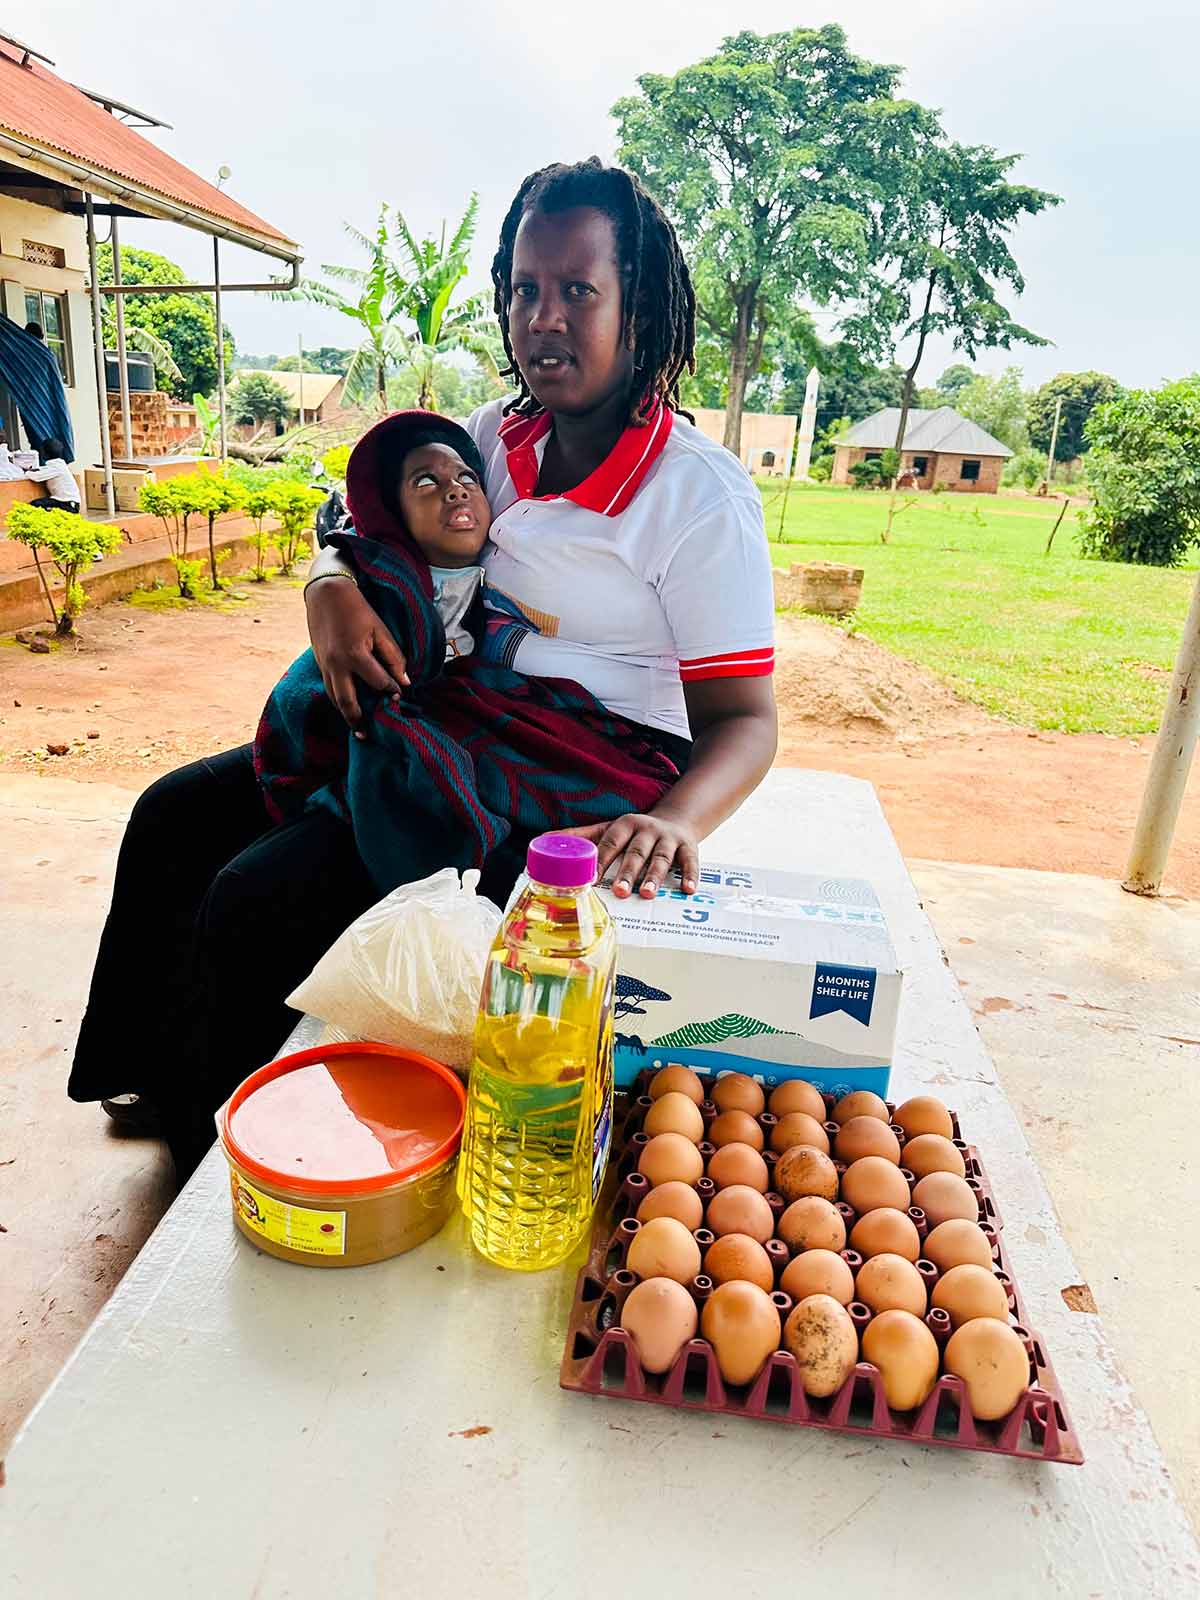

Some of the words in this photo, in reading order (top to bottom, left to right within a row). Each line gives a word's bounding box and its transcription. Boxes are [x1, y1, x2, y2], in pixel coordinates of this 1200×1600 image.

[642, 919, 666, 927] STACK
[692, 924, 714, 932] THAN
[721, 927, 758, 937] CARTONS
[700, 933, 747, 943] ODOURLESS
[748, 938, 774, 946] PLACE
[817, 974, 824, 983] 6
[825, 975, 870, 988] MONTHS
[816, 986, 847, 998] SHELF
[848, 990, 869, 1001] LIFE
